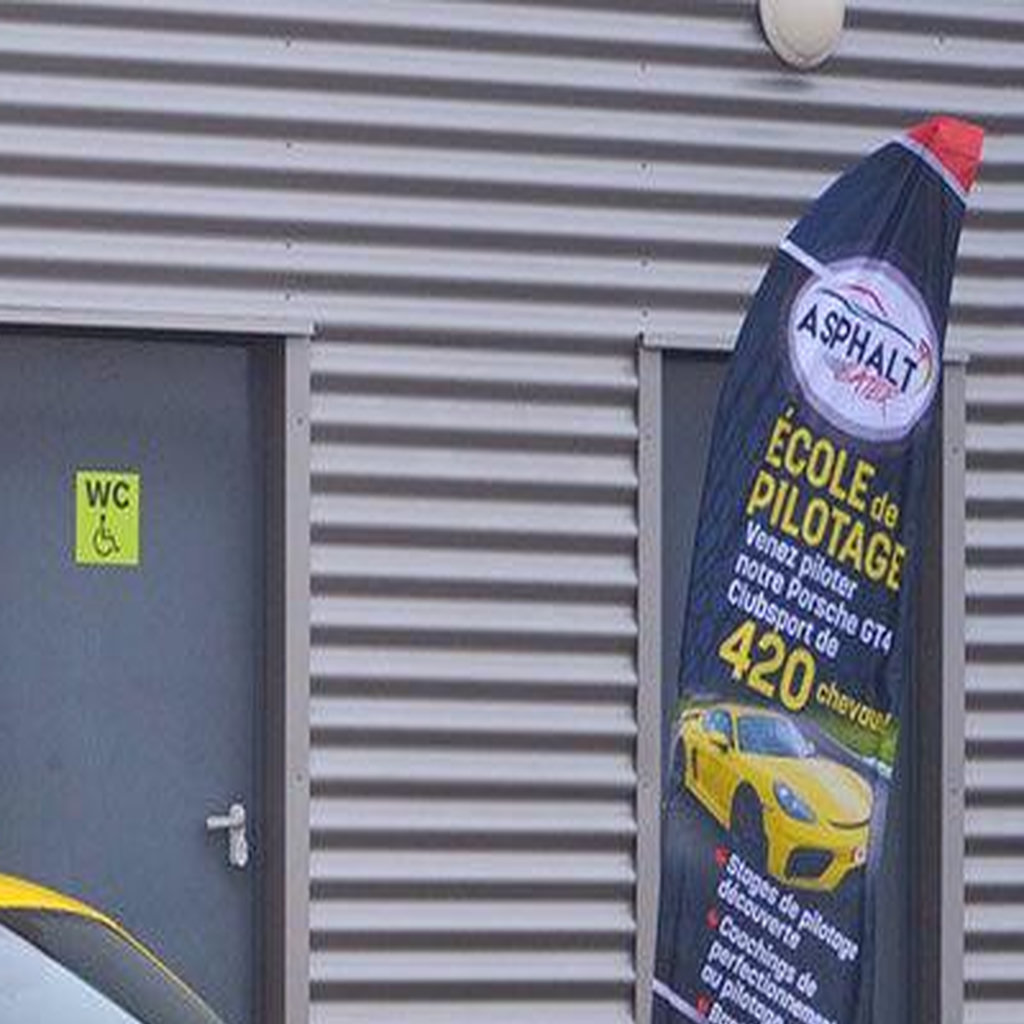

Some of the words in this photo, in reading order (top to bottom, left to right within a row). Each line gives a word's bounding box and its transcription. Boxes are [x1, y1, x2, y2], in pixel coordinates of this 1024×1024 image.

[797, 304, 918, 393] ASPHALT
[85, 480, 130, 509] WC
[765, 406, 875, 512] ÉCOLE
[870, 492, 899, 528] de
[746, 469, 907, 590] PILOTAGE
[746, 520, 798, 568] Venez
[799, 555, 858, 599] piloter
[727, 579, 814, 646] Clubsport
[815, 627, 839, 658] de
[734, 554, 784, 594] notre
[787, 578, 858, 635] Porsche
[860, 619, 893, 651] GT4
[719, 620, 816, 711] 420
[717, 880, 801, 949] découverte
[727, 853, 779, 905] Stages
[779, 893, 800, 920] de
[798, 909, 859, 961] pilotage
[719, 916, 797, 984] Coachings
[797, 972, 818, 997] de
